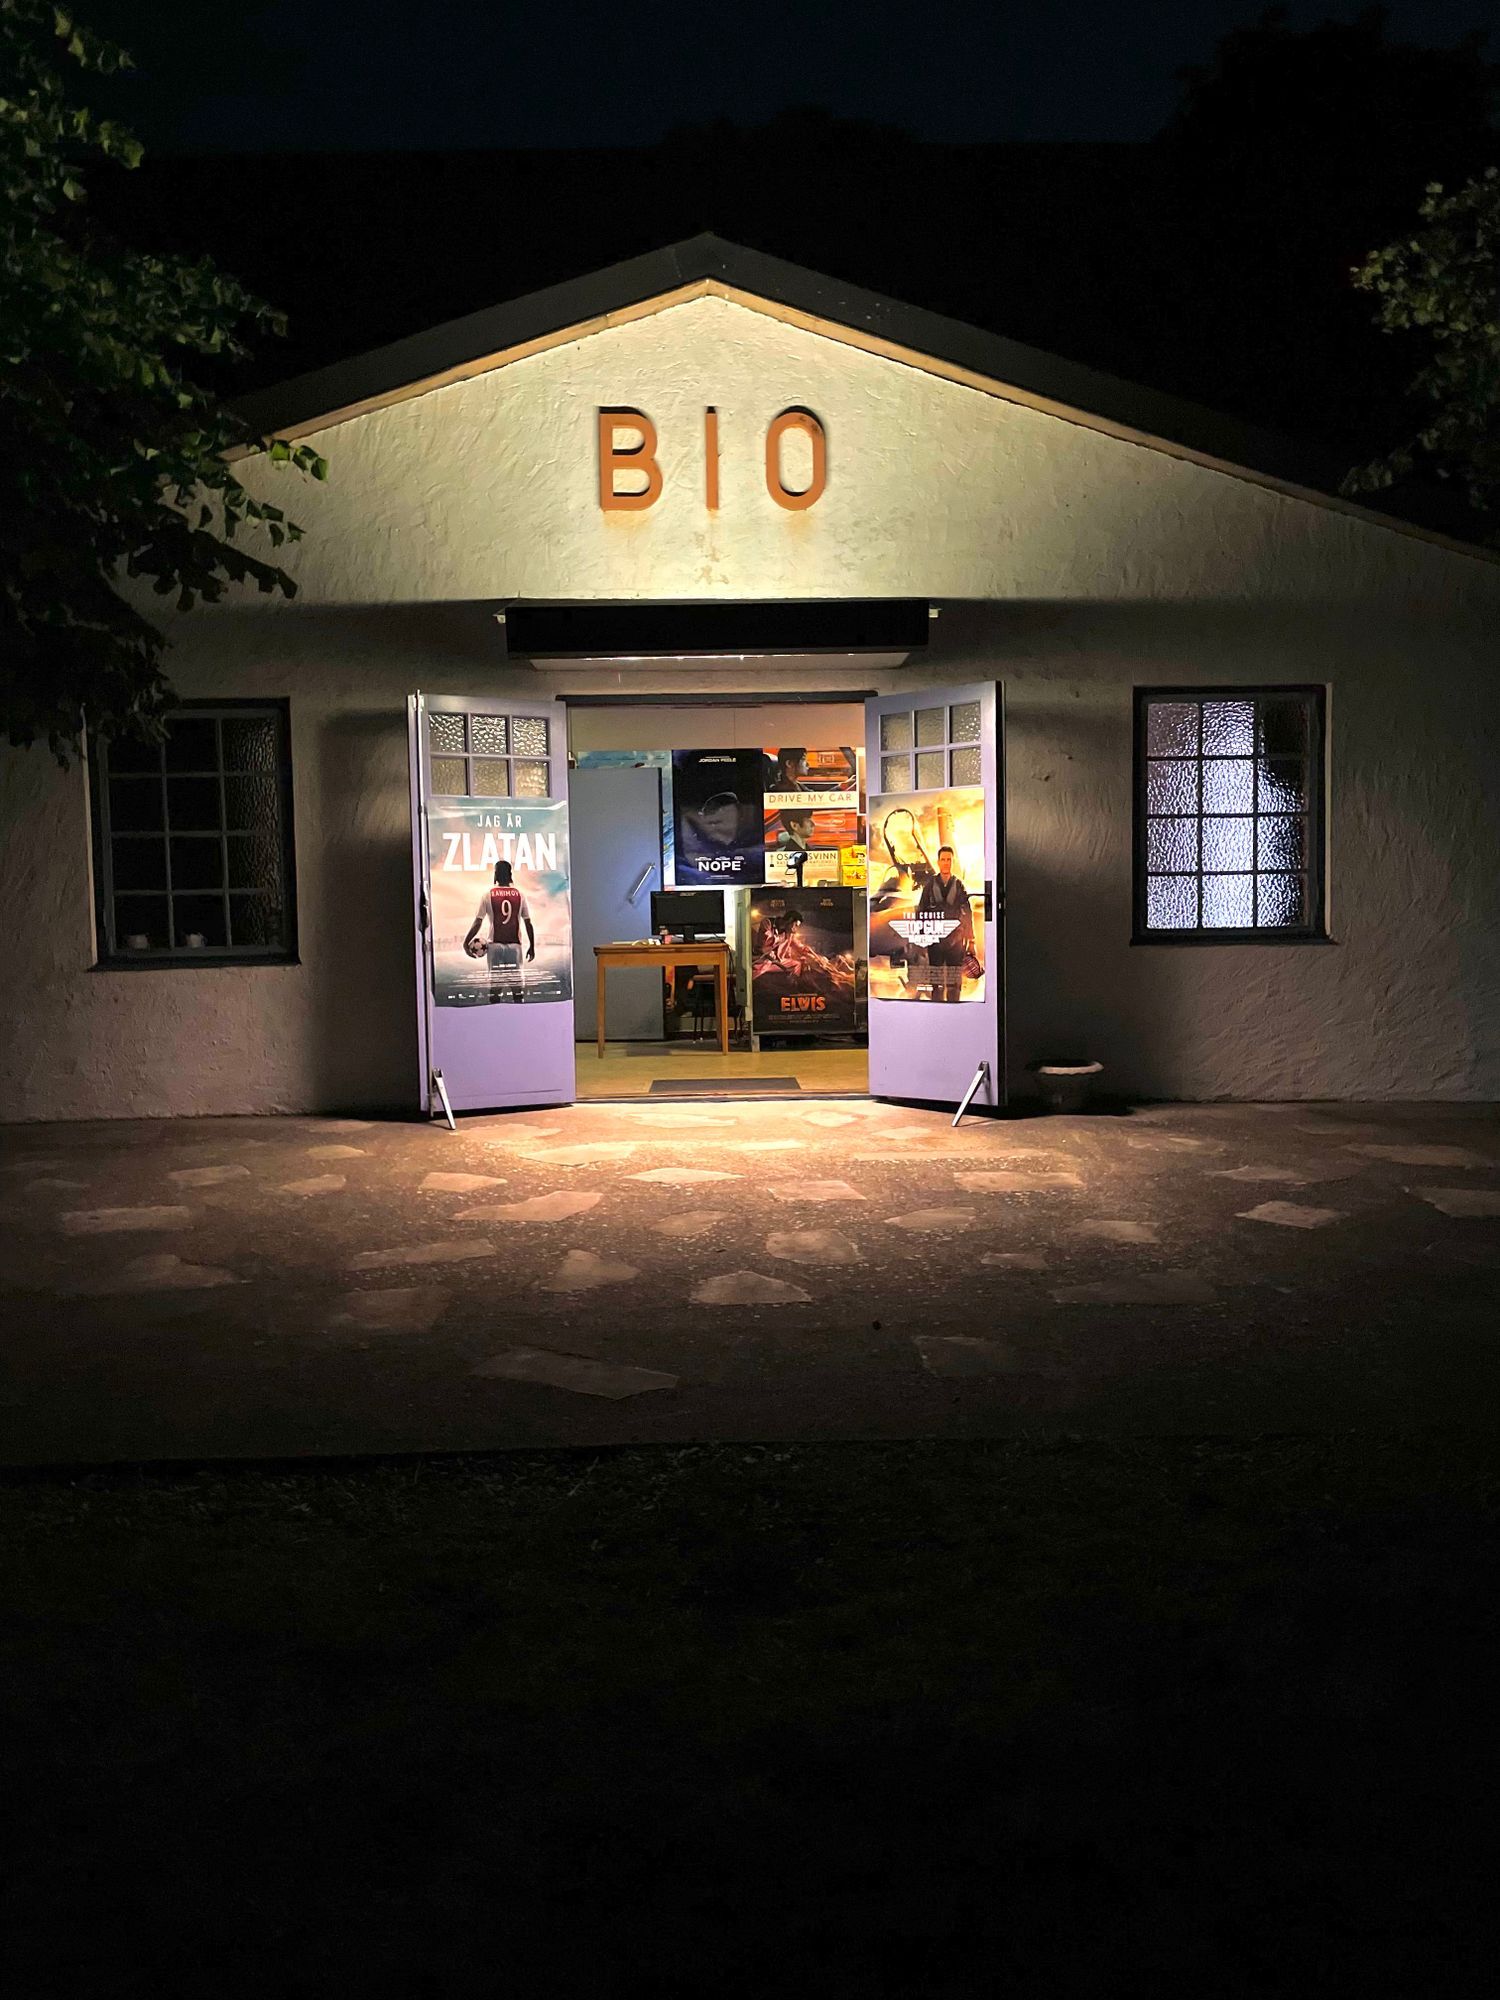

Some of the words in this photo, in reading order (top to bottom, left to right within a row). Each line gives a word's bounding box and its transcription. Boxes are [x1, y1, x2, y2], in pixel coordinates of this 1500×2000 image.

[598, 405, 827, 512] BIO
[768, 794, 802, 804] DRIVE
[808, 794, 824, 803] MY
[829, 793, 852, 802] CAR
[477, 815, 500, 829] JAG
[506, 812, 522, 828] ÄR
[442, 832, 558, 872] ZLATAN
[776, 852, 837, 861] OSSVINN
[698, 861, 742, 871] NOPE
[501, 900, 512, 925] 9
[919, 911, 945, 920] CRUISE
[781, 996, 826, 1012] ELVIS
